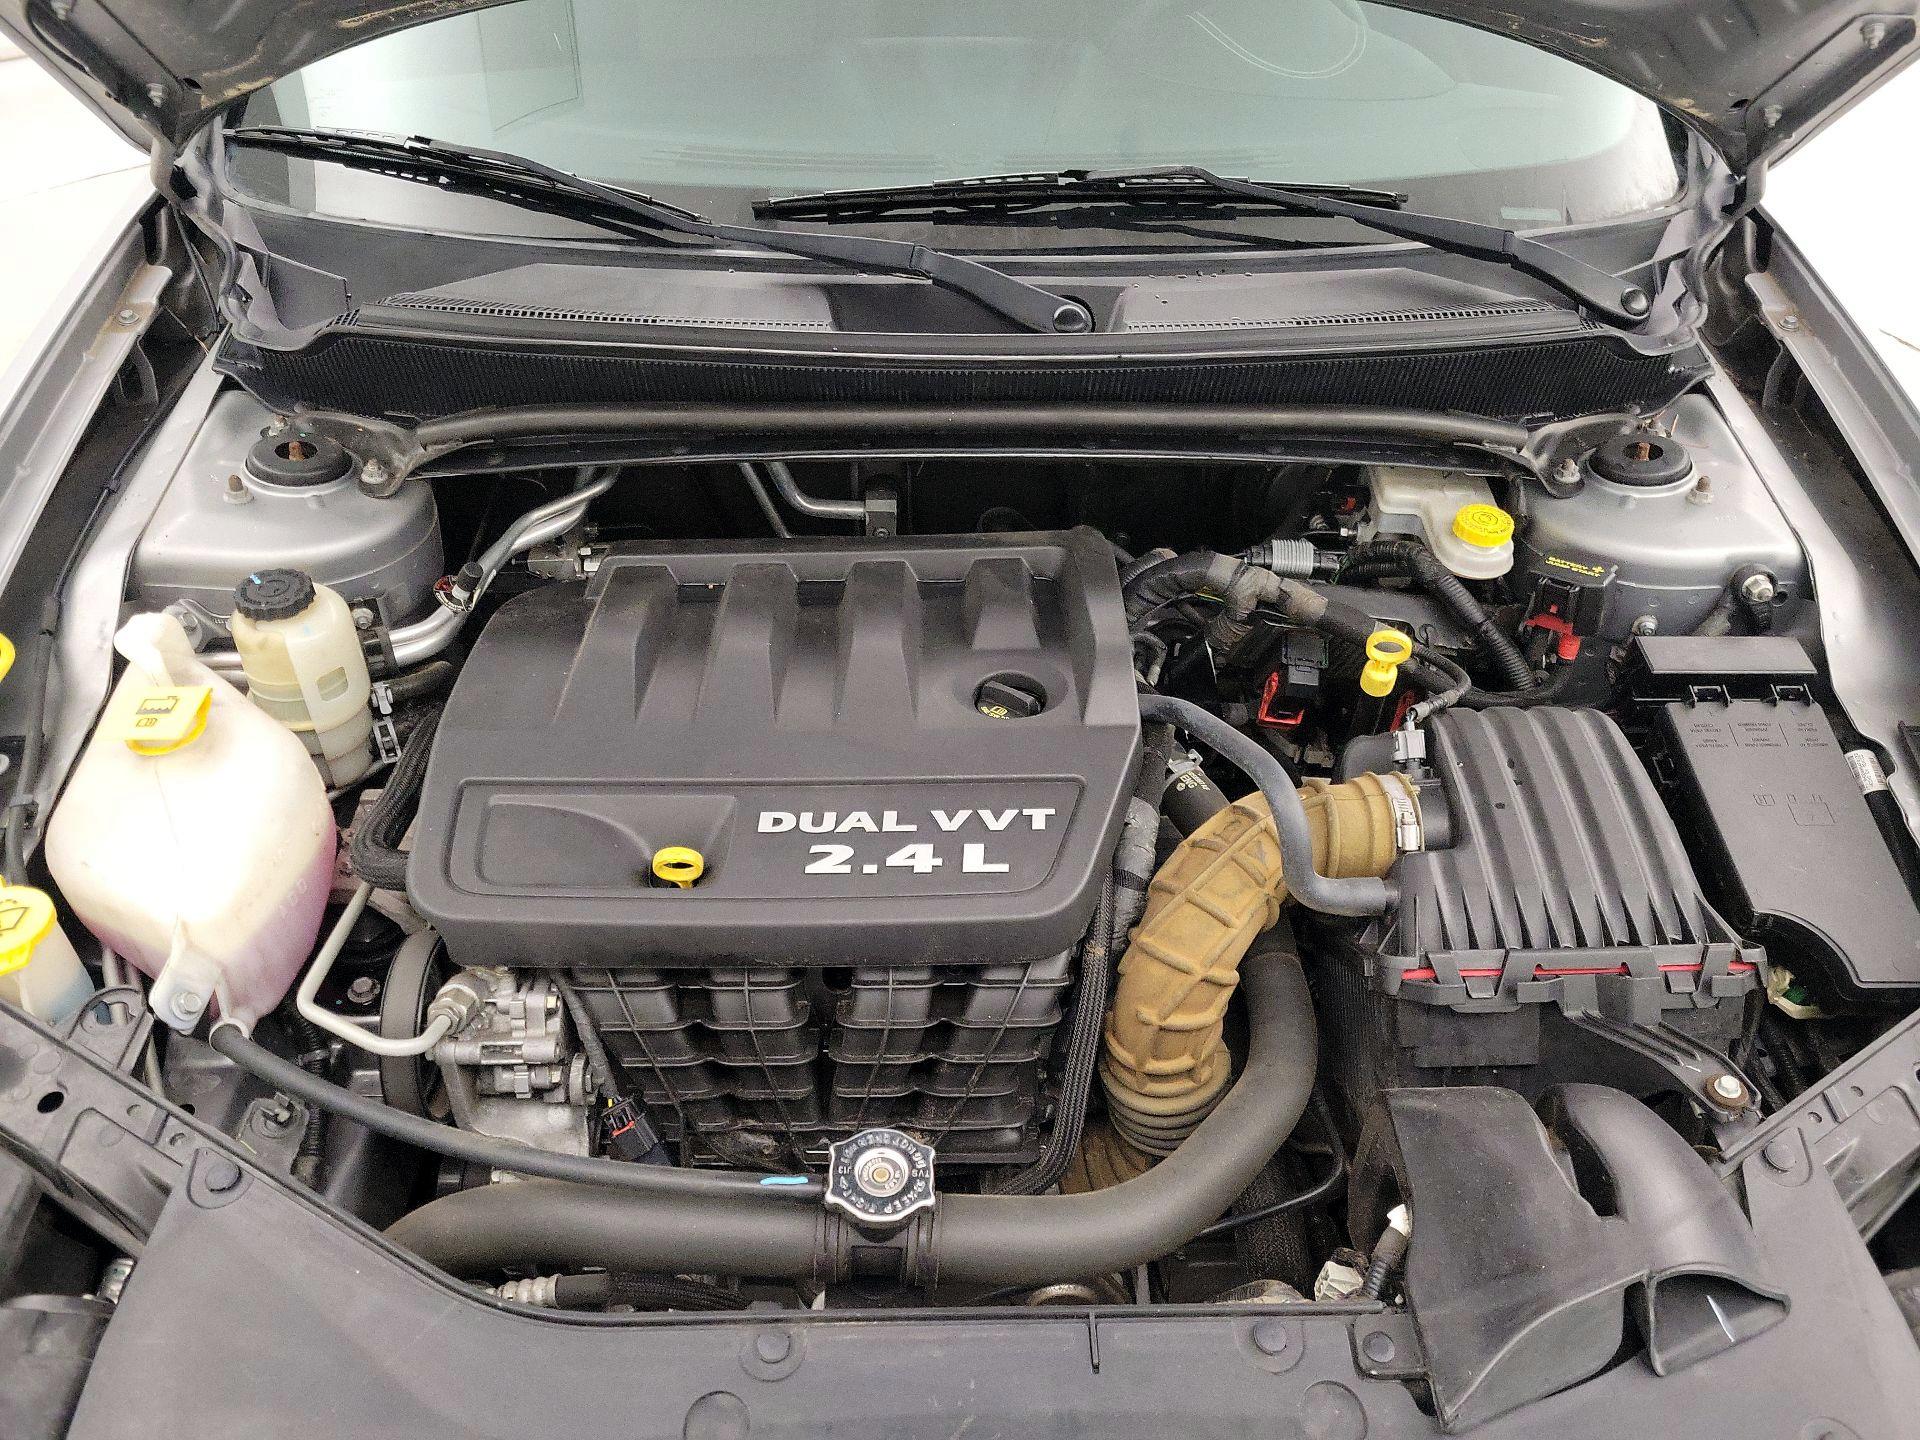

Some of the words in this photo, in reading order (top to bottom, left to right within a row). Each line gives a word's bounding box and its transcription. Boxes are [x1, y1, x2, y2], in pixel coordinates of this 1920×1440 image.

[1545, 560, 1570, 569] JUMP
[1571, 567, 1601, 577] START
[1548, 556, 1588, 570] BATTERY
[1179, 774, 1198, 789] ENG
[757, 811, 917, 833] DUAL
[930, 808, 1056, 831] VVT
[804, 843, 943, 874] 2.4
[962, 843, 1010, 873] L
[884, 1190, 918, 1214] KEEP
